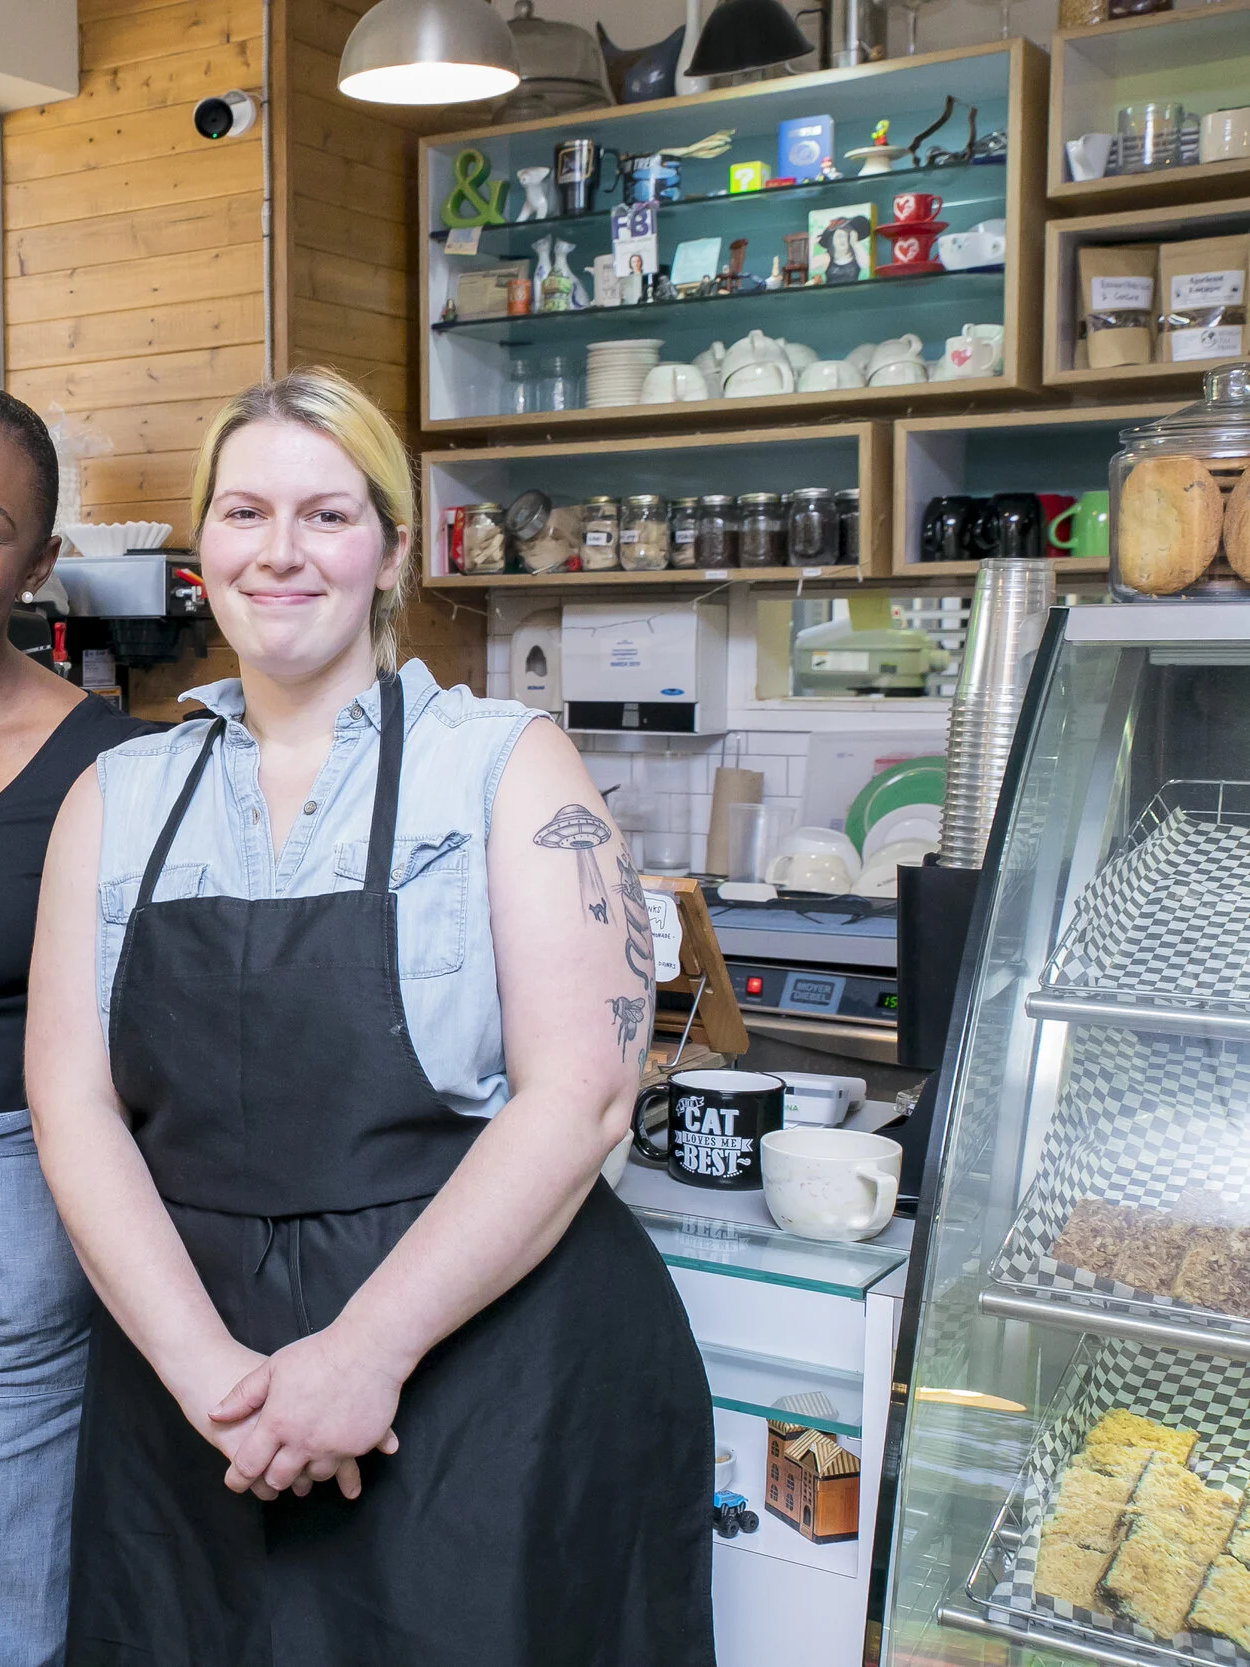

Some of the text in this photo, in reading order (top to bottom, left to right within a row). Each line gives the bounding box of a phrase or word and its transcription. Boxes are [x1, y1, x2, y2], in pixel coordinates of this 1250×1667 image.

[612, 210, 657, 239] FBI
[796, 982, 831, 993] MOYER
[685, 1107, 740, 1136] CAT
[686, 1133, 737, 1148] LOVES ME
[683, 1144, 741, 1176] BEST
